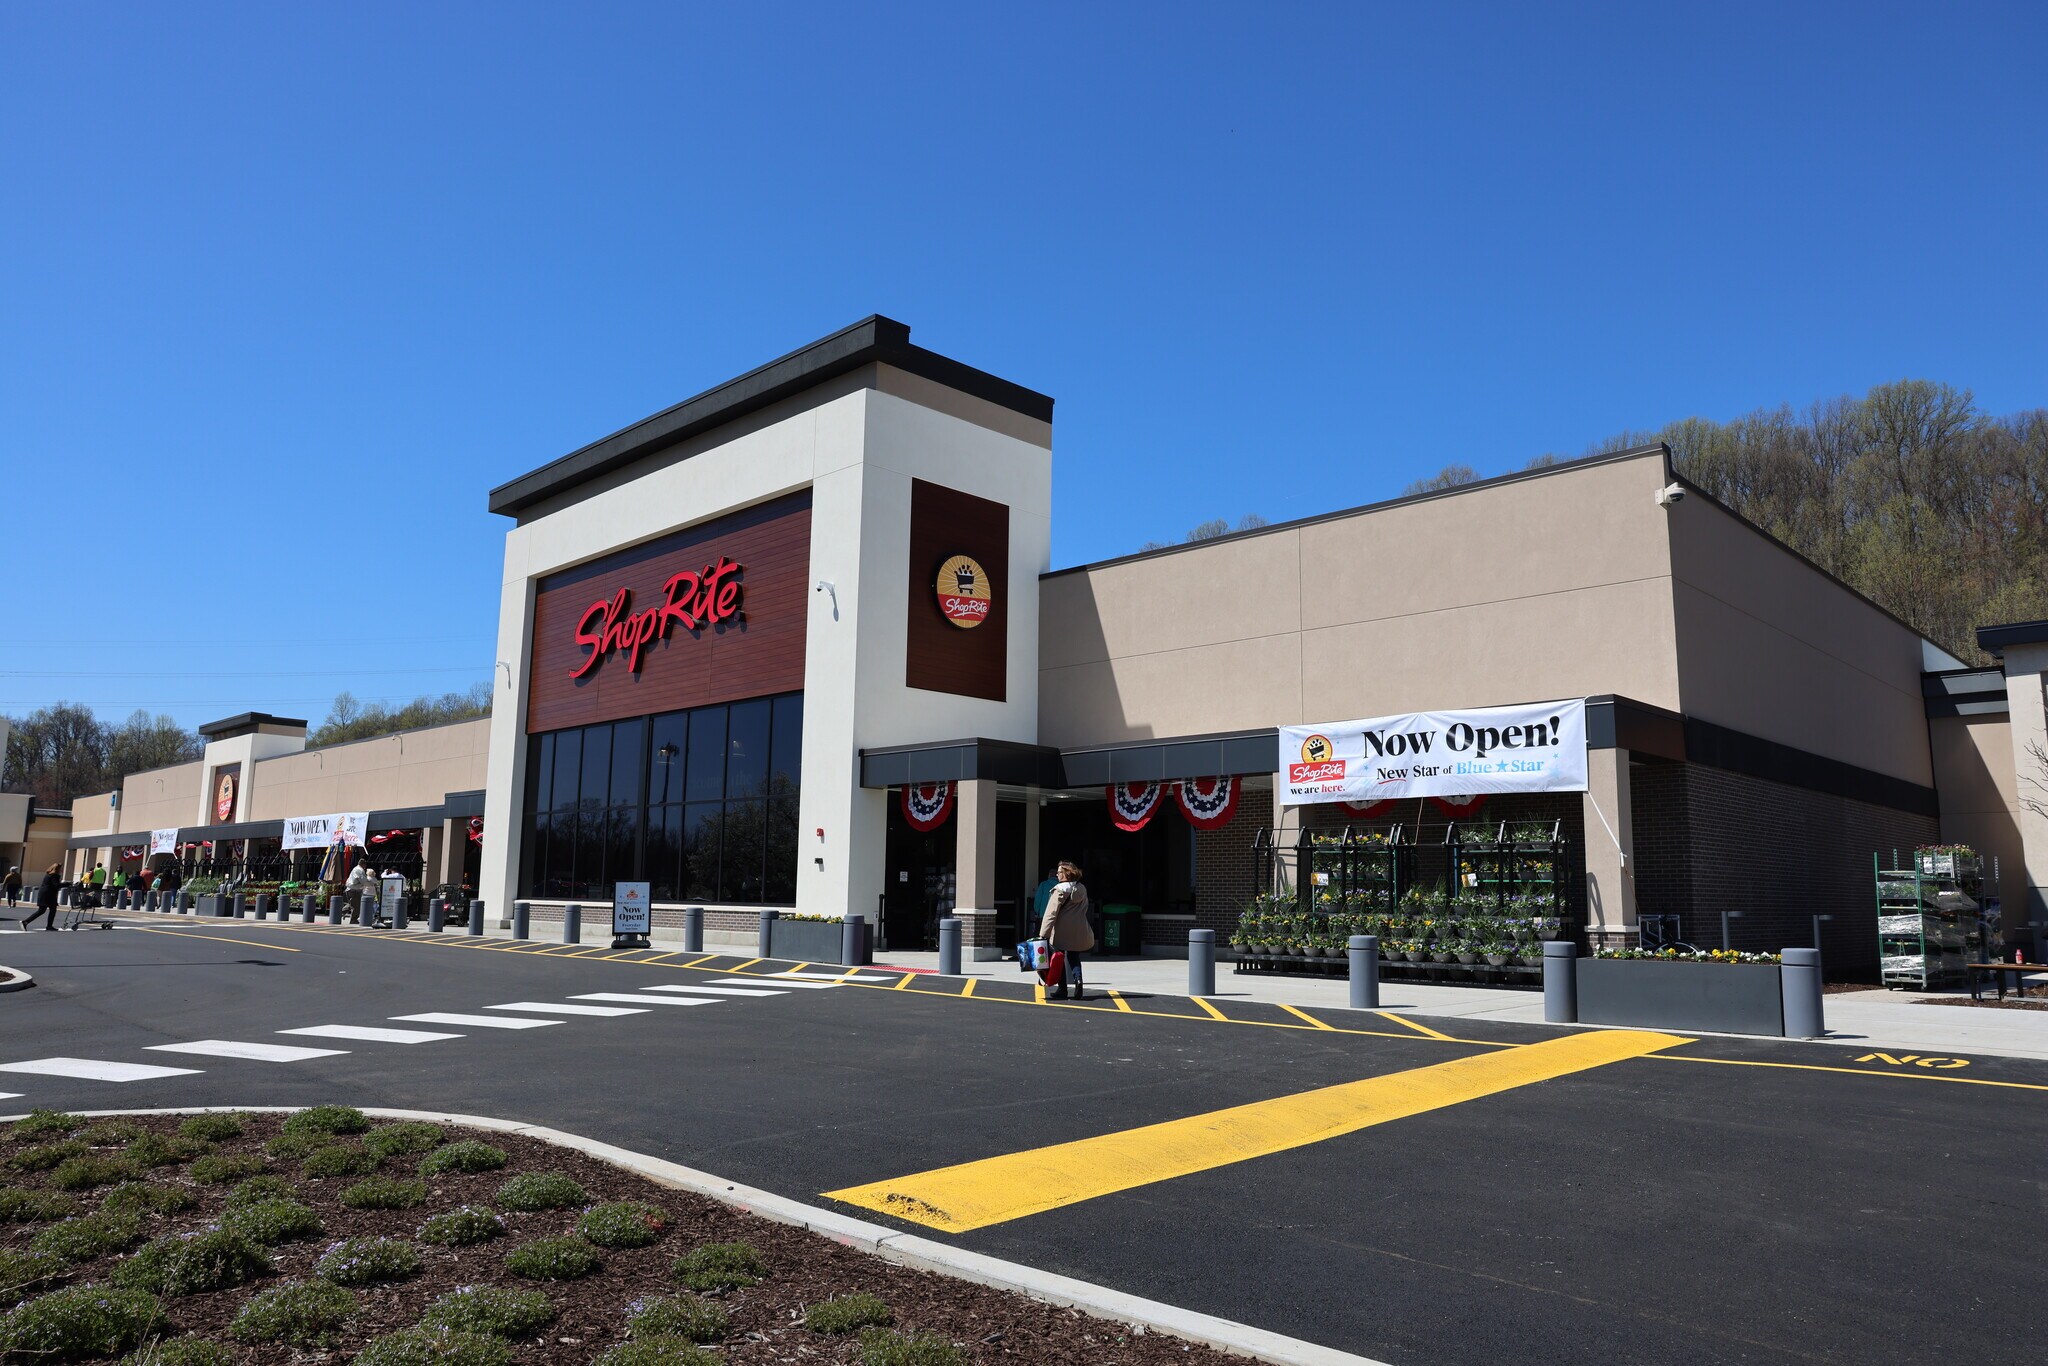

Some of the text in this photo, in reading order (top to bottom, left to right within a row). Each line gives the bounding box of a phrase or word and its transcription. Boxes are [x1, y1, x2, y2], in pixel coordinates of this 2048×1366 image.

[945, 598, 988, 616] ShopRite
[569, 556, 740, 678] ShopRite
[1361, 715, 1560, 759] Now Open!
[1292, 763, 1343, 782] ShopRite
[1376, 759, 1545, 780] New Star of Blue Star
[1290, 784, 1346, 795] we are here.
[618, 913, 645, 922] Open!
[623, 906, 642, 914] Now
[1853, 1052, 1971, 1069] NO
